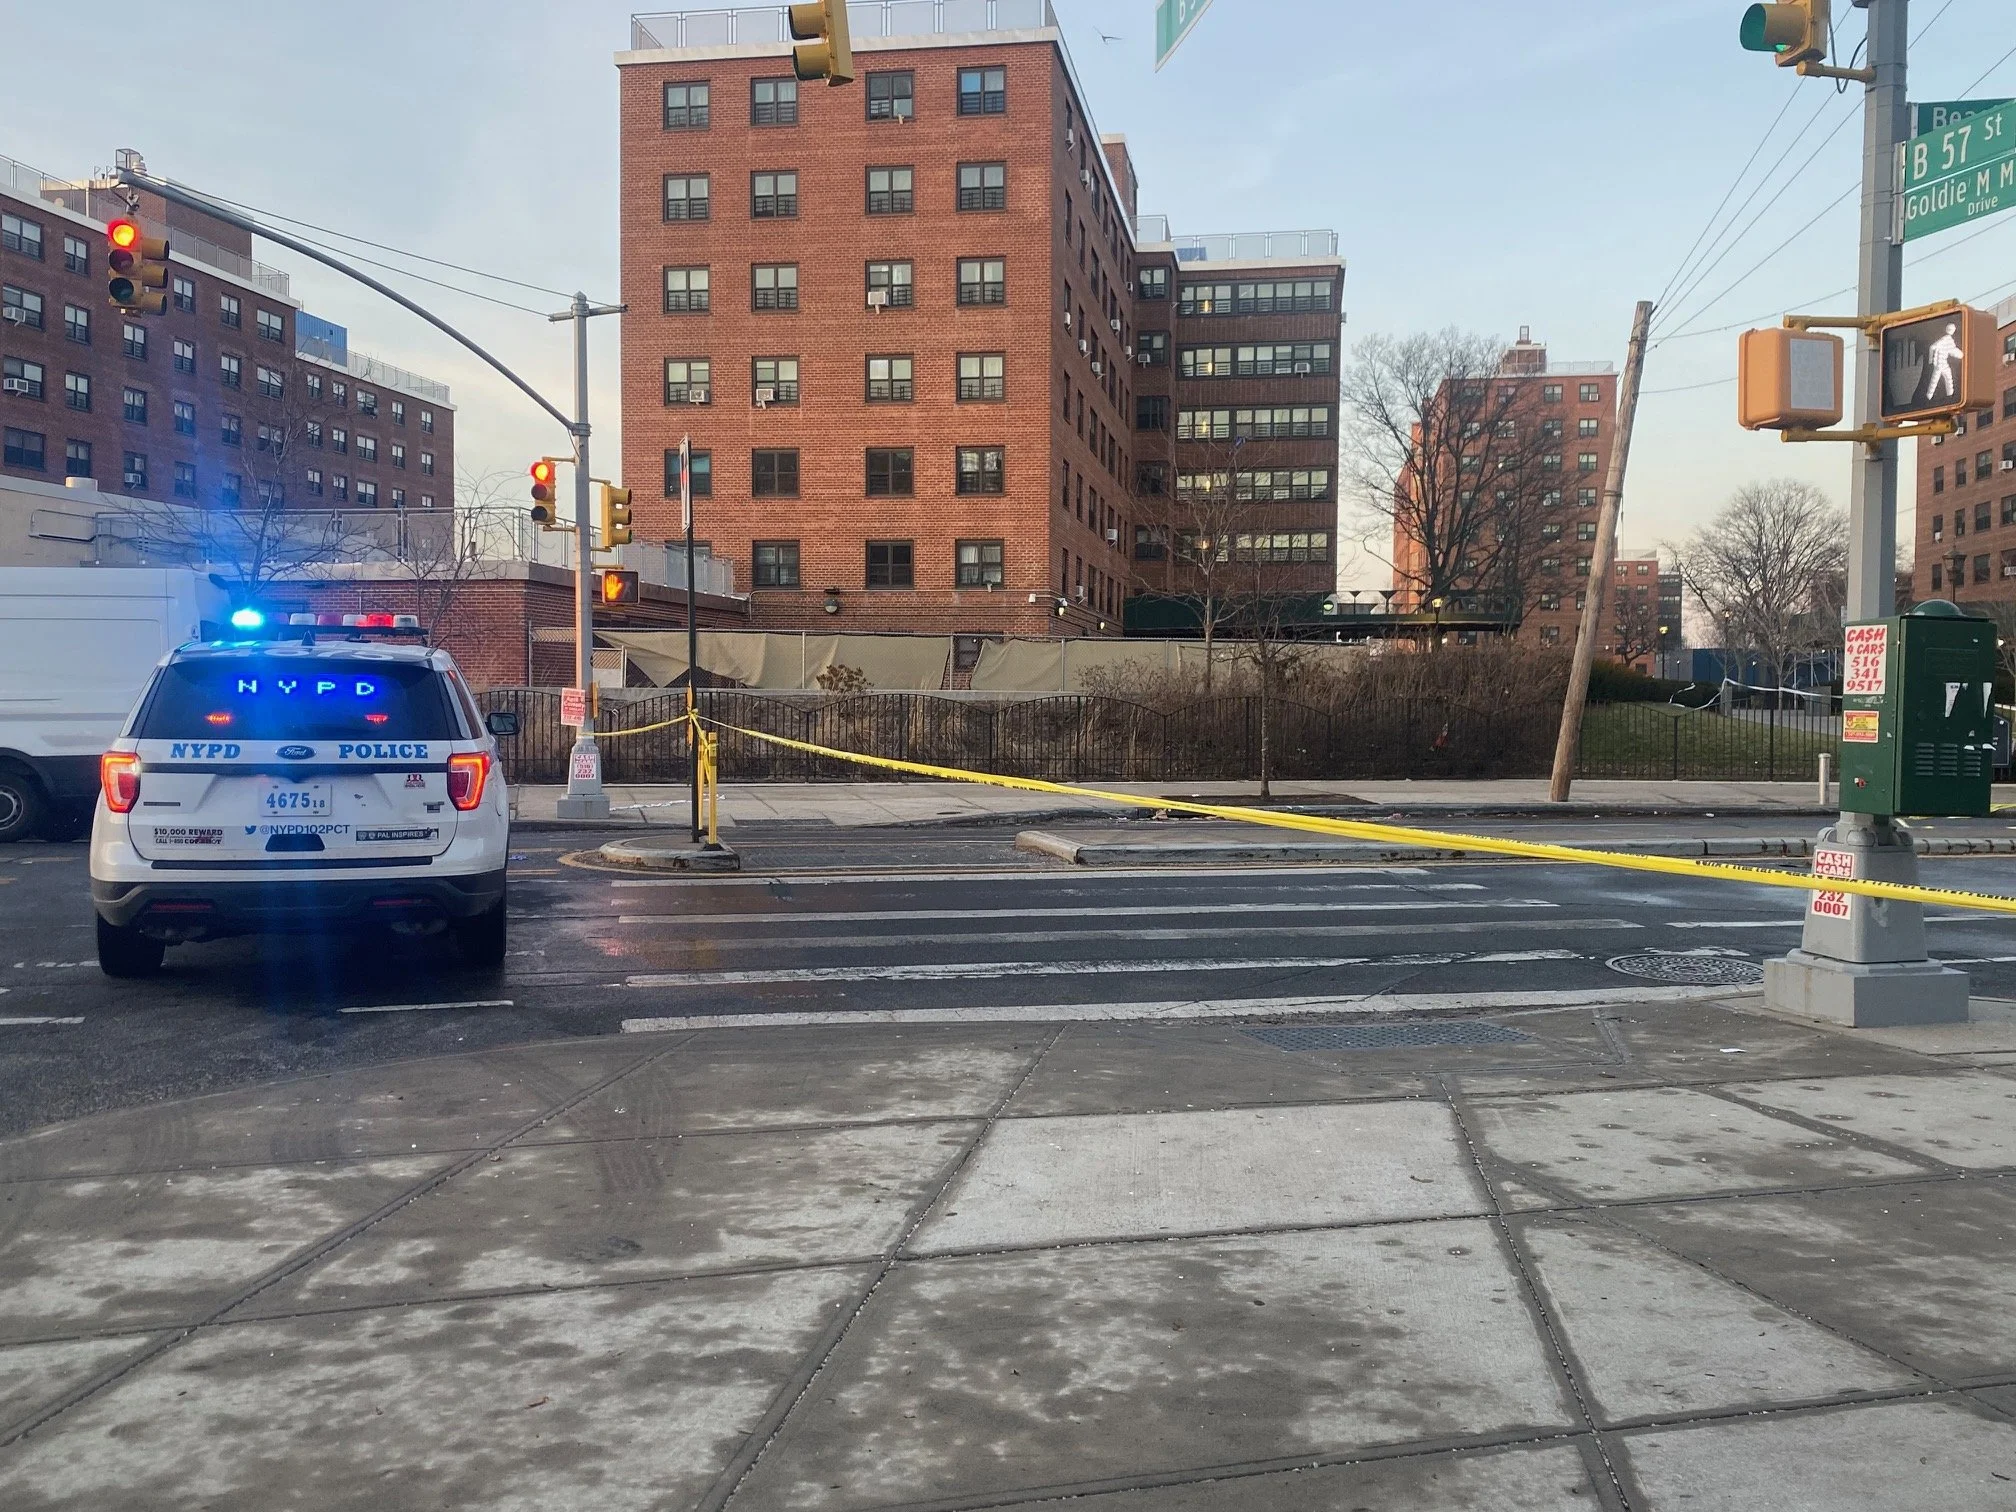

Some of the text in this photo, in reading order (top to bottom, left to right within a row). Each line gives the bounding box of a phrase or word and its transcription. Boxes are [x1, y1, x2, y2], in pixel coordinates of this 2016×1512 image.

[1913, 113, 2003, 181] B 57 St
[1907, 179, 1967, 220] Goldie
[1976, 168, 1990, 197] M
[1967, 195, 1999, 216] Drive
[1846, 644, 1854, 655] 4
[1850, 656, 1881, 668] 516
[1851, 667, 1879, 679] 341
[1846, 679, 1883, 692] 9517
[170, 742, 242, 759] NYPD
[284, 746, 307, 757] Ford
[338, 743, 429, 759] POLICE
[266, 792, 326, 809] 4675 18
[154, 827, 223, 837] $10,000 REWARD
[260, 824, 351, 835] @NYPD102PCT
[391, 830, 424, 839] INSPIRES
[1818, 889, 1845, 903] 232
[1813, 900, 1849, 916] 0007
